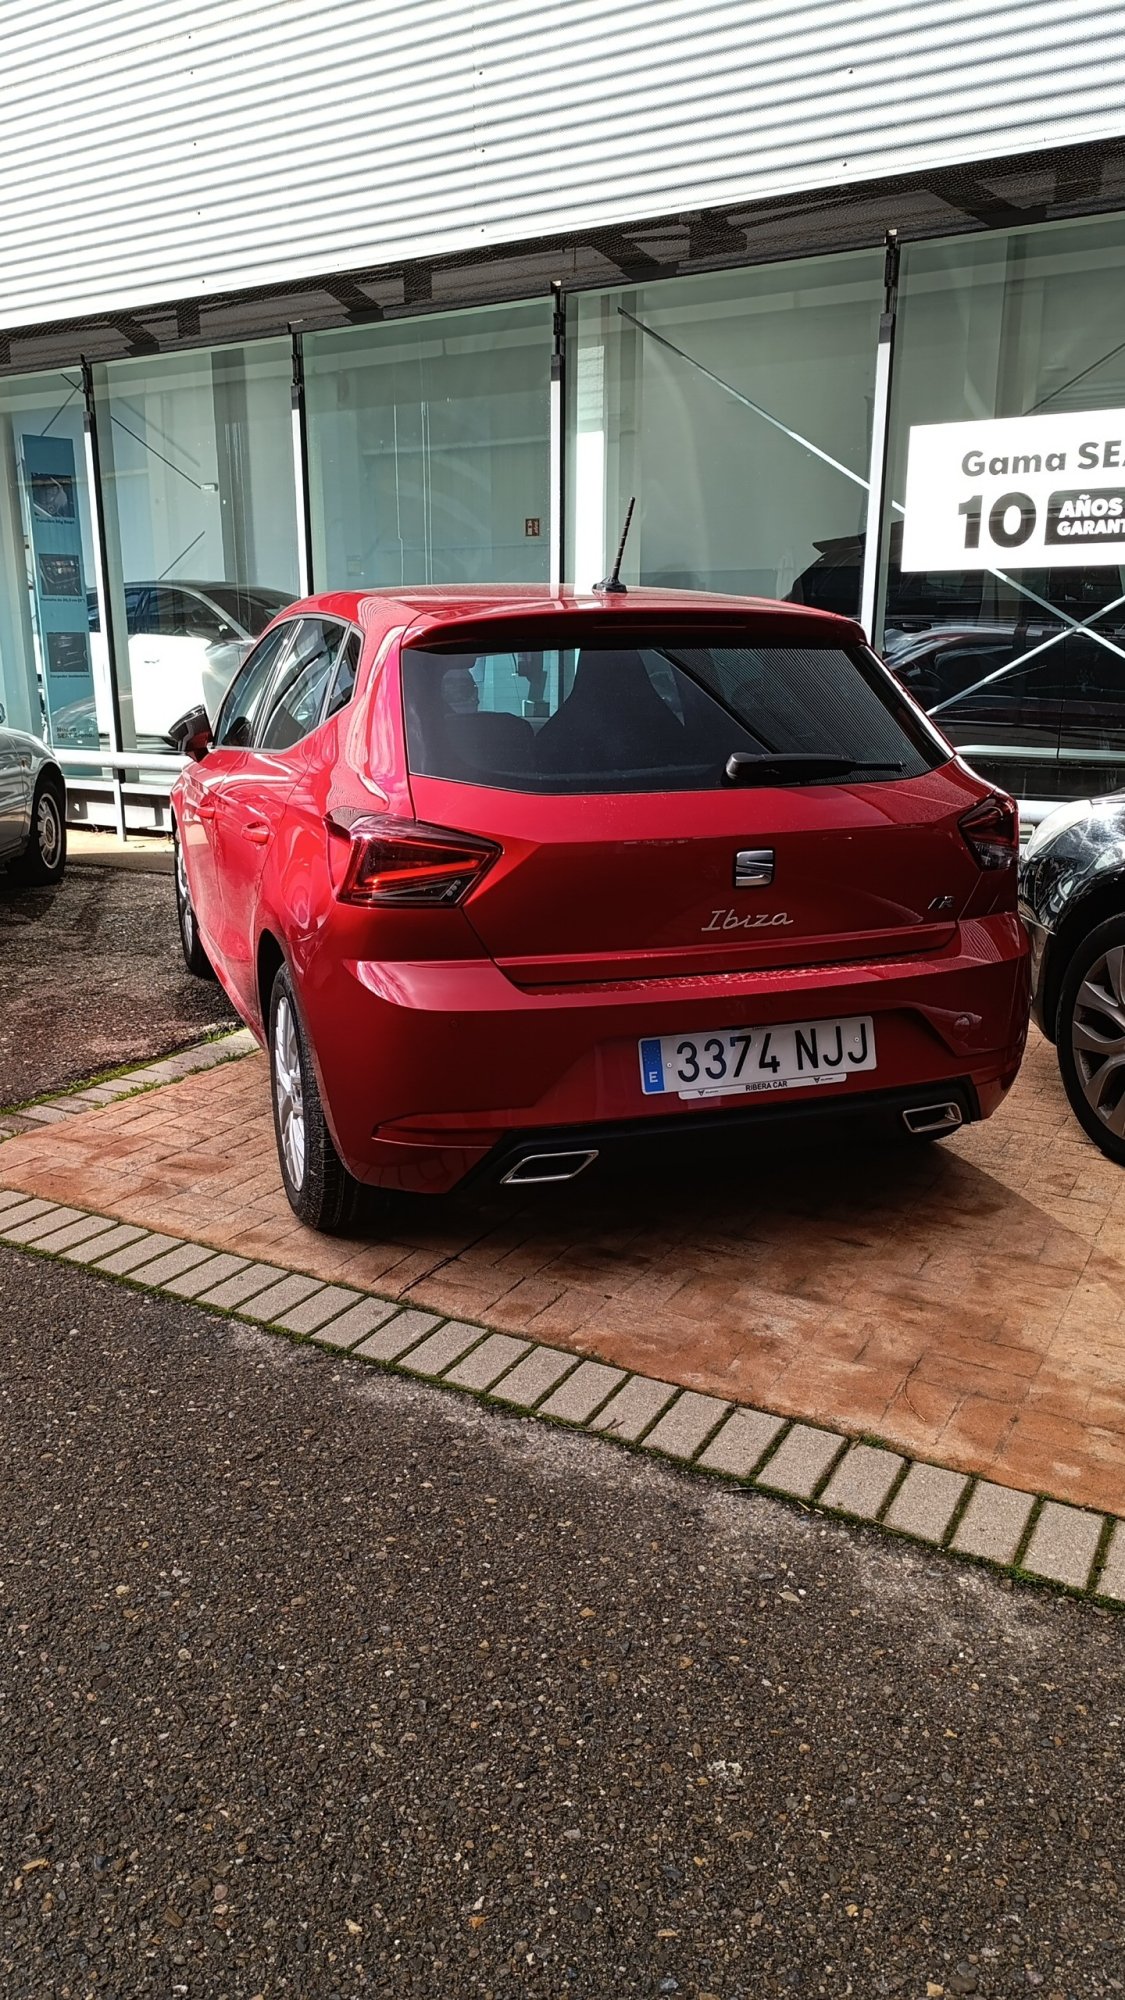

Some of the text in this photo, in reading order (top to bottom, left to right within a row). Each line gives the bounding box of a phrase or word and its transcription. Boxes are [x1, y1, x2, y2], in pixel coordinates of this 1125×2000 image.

[961, 440, 1125, 477] Gama SE
[1058, 494, 1124, 519] AÑOS
[958, 491, 1037, 549] 10
[701, 908, 794, 932] Ibiza
[676, 1022, 868, 1083] 3374 NJJ
[648, 1071, 659, 1083] E
[745, 1080, 788, 1092] RIBERA CAR
